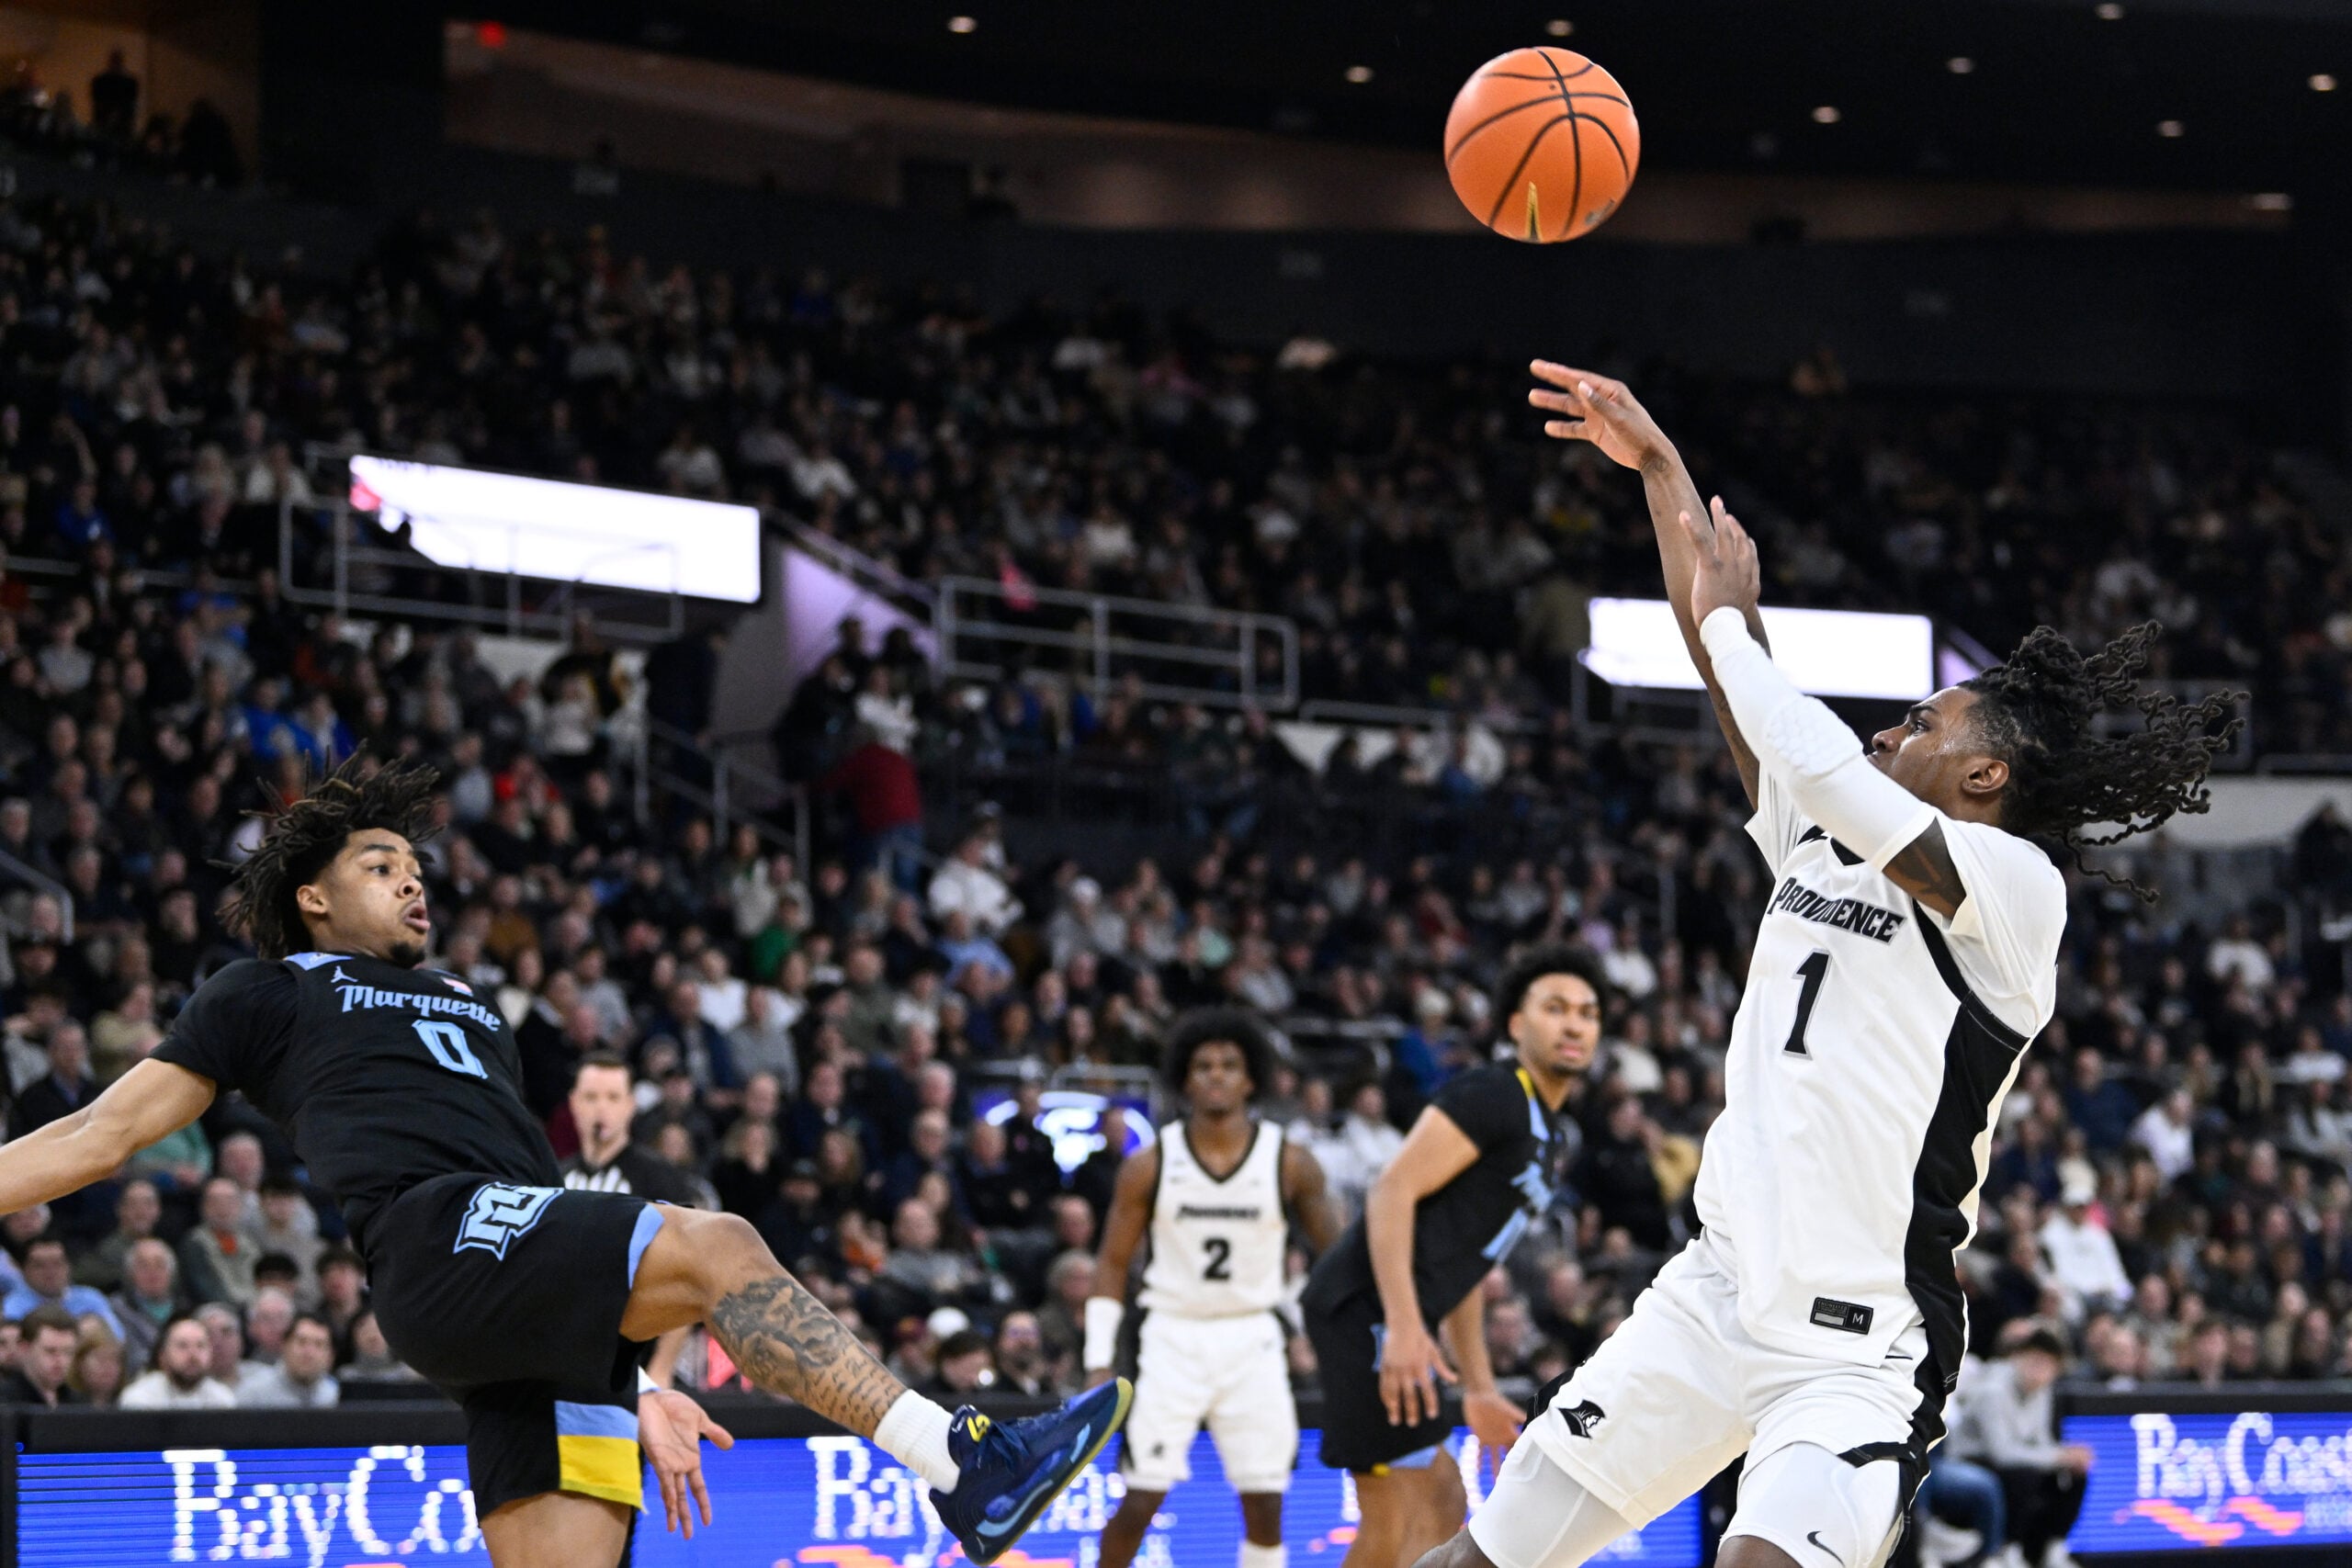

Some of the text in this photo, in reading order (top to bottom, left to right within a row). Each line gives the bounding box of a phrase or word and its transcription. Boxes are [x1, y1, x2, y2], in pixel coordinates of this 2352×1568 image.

[1768, 876, 1906, 945] PROVIDENCE
[335, 985, 501, 1032] Marquette
[1782, 948, 1831, 1060] 1
[412, 1019, 488, 1079] 0
[1203, 1238, 1232, 1281] 2
[1852, 1313, 1864, 1325] M
[161, 1445, 487, 1568] BayCo
